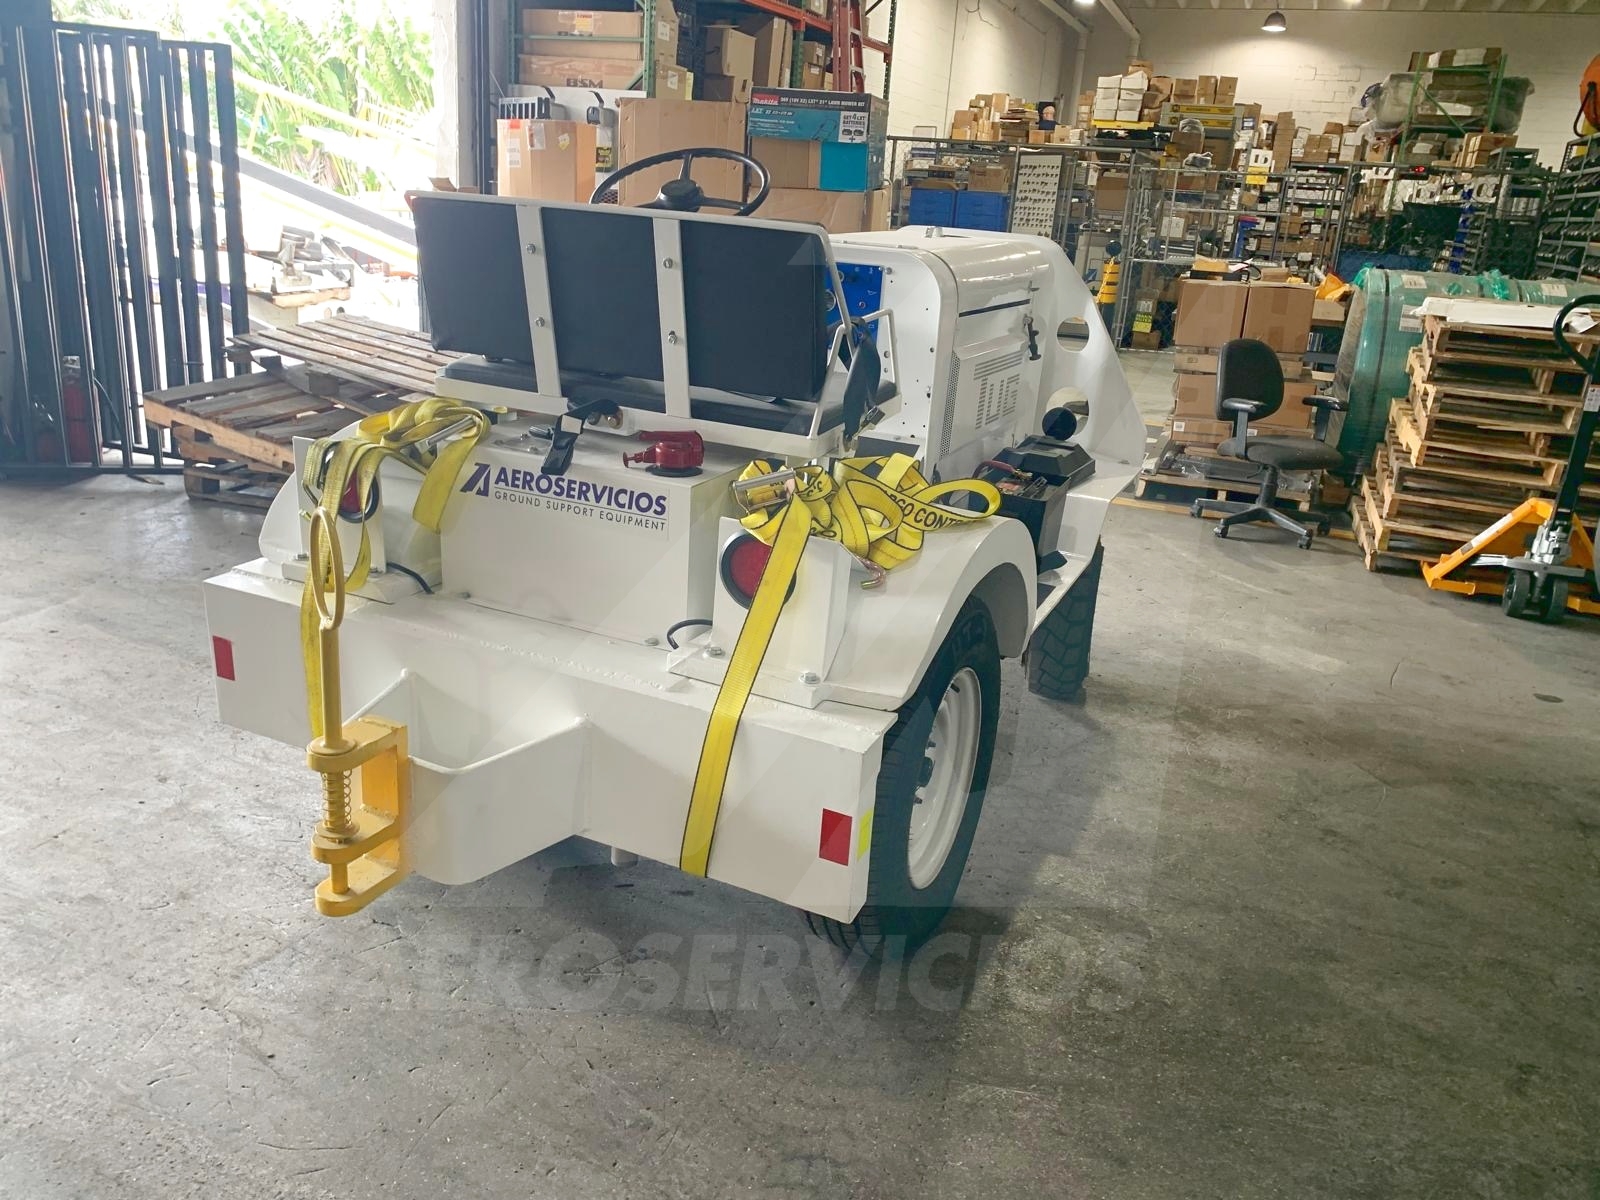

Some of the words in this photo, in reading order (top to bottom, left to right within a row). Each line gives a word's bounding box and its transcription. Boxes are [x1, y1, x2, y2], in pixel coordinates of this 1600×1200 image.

[566, 78, 603, 89] BSM
[494, 467, 667, 516] AEROSERVICIOS
[494, 491, 541, 507] GROUND
[546, 500, 594, 517] SUPPORT
[599, 510, 665, 531] EQUIPMENT
